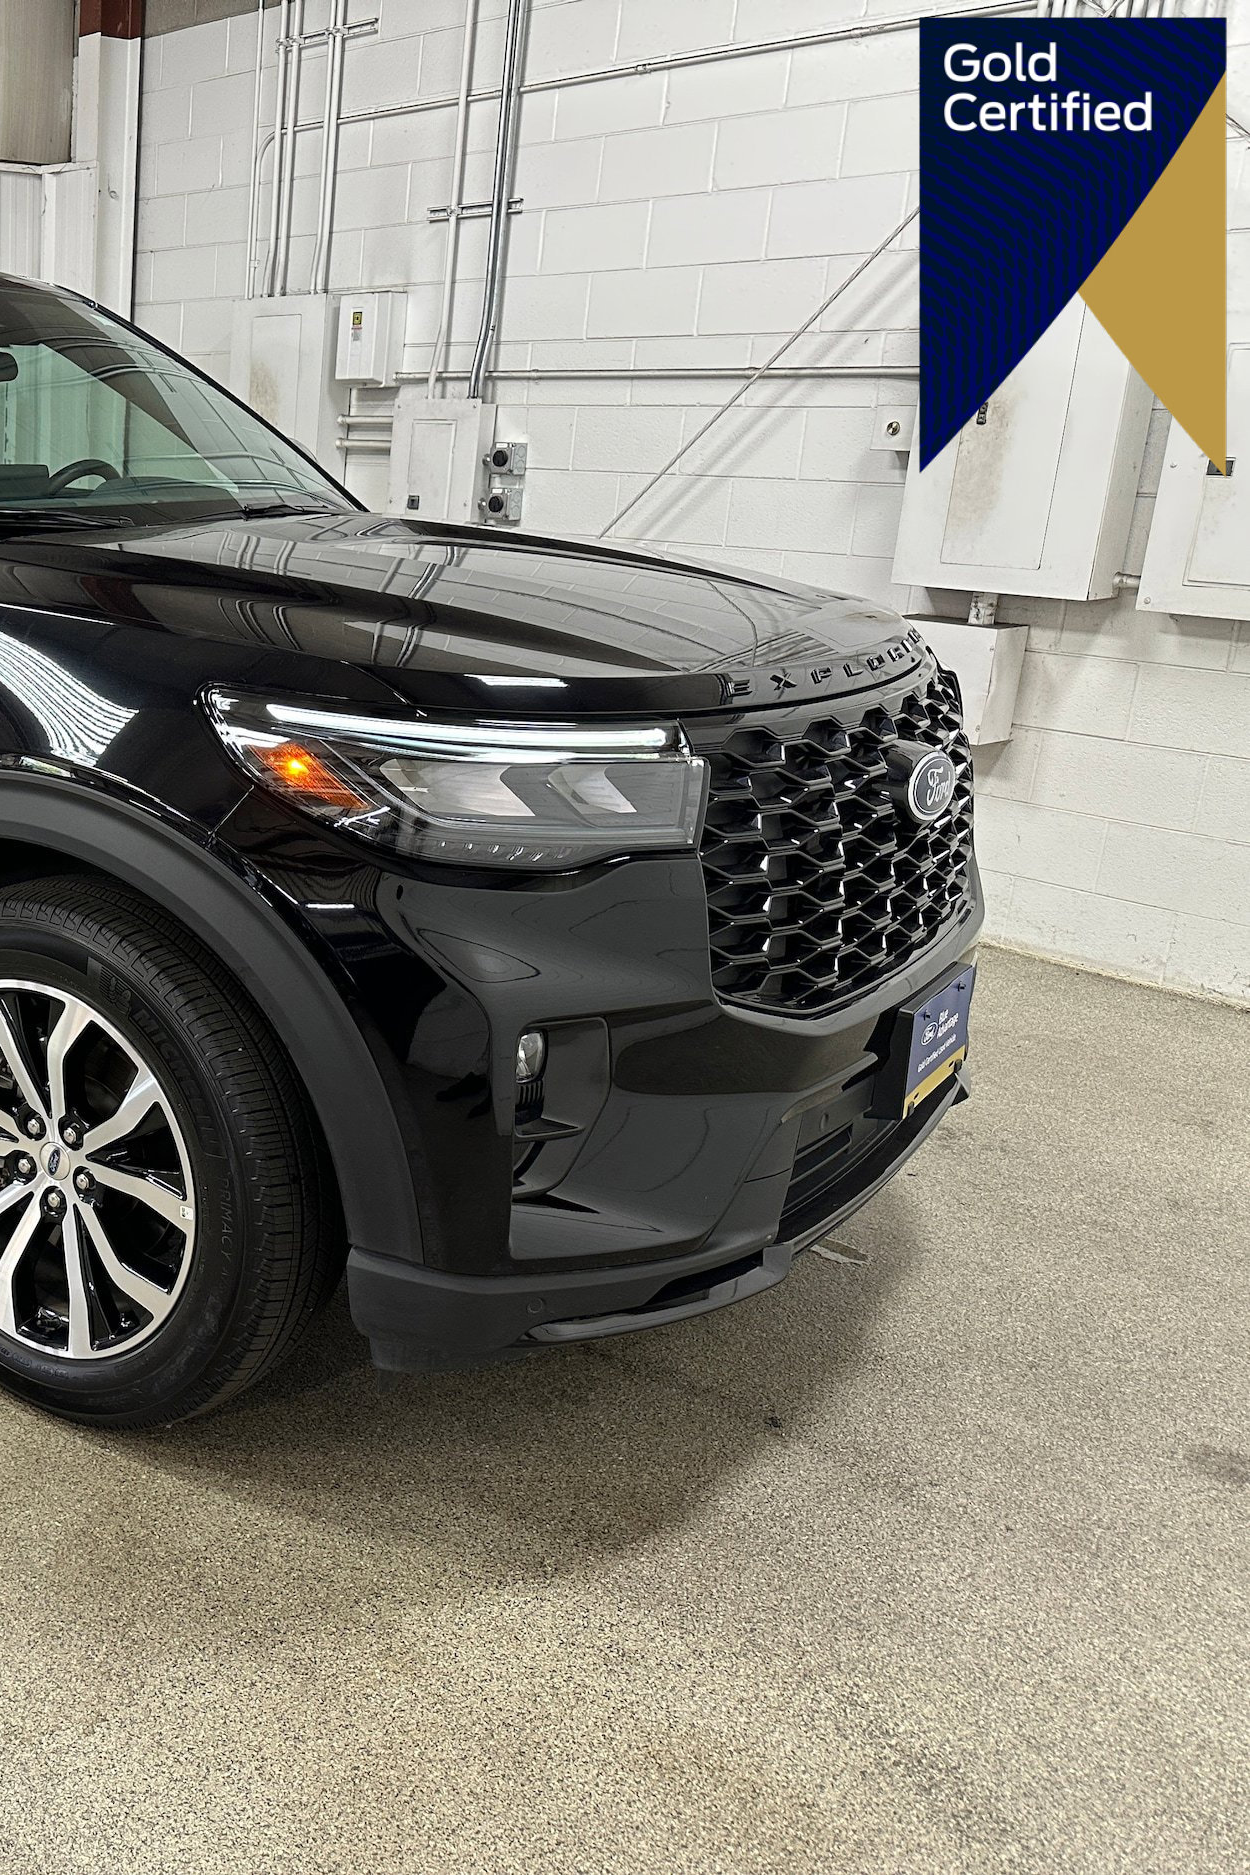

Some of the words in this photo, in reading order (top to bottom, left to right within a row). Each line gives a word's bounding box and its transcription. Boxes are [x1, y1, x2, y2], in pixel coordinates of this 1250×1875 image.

[926, 765, 951, 807] Ford
[936, 1012, 959, 1039] Advantage
[938, 1009, 949, 1025] Blue
[217, 1175, 233, 1262] PRIMACY
